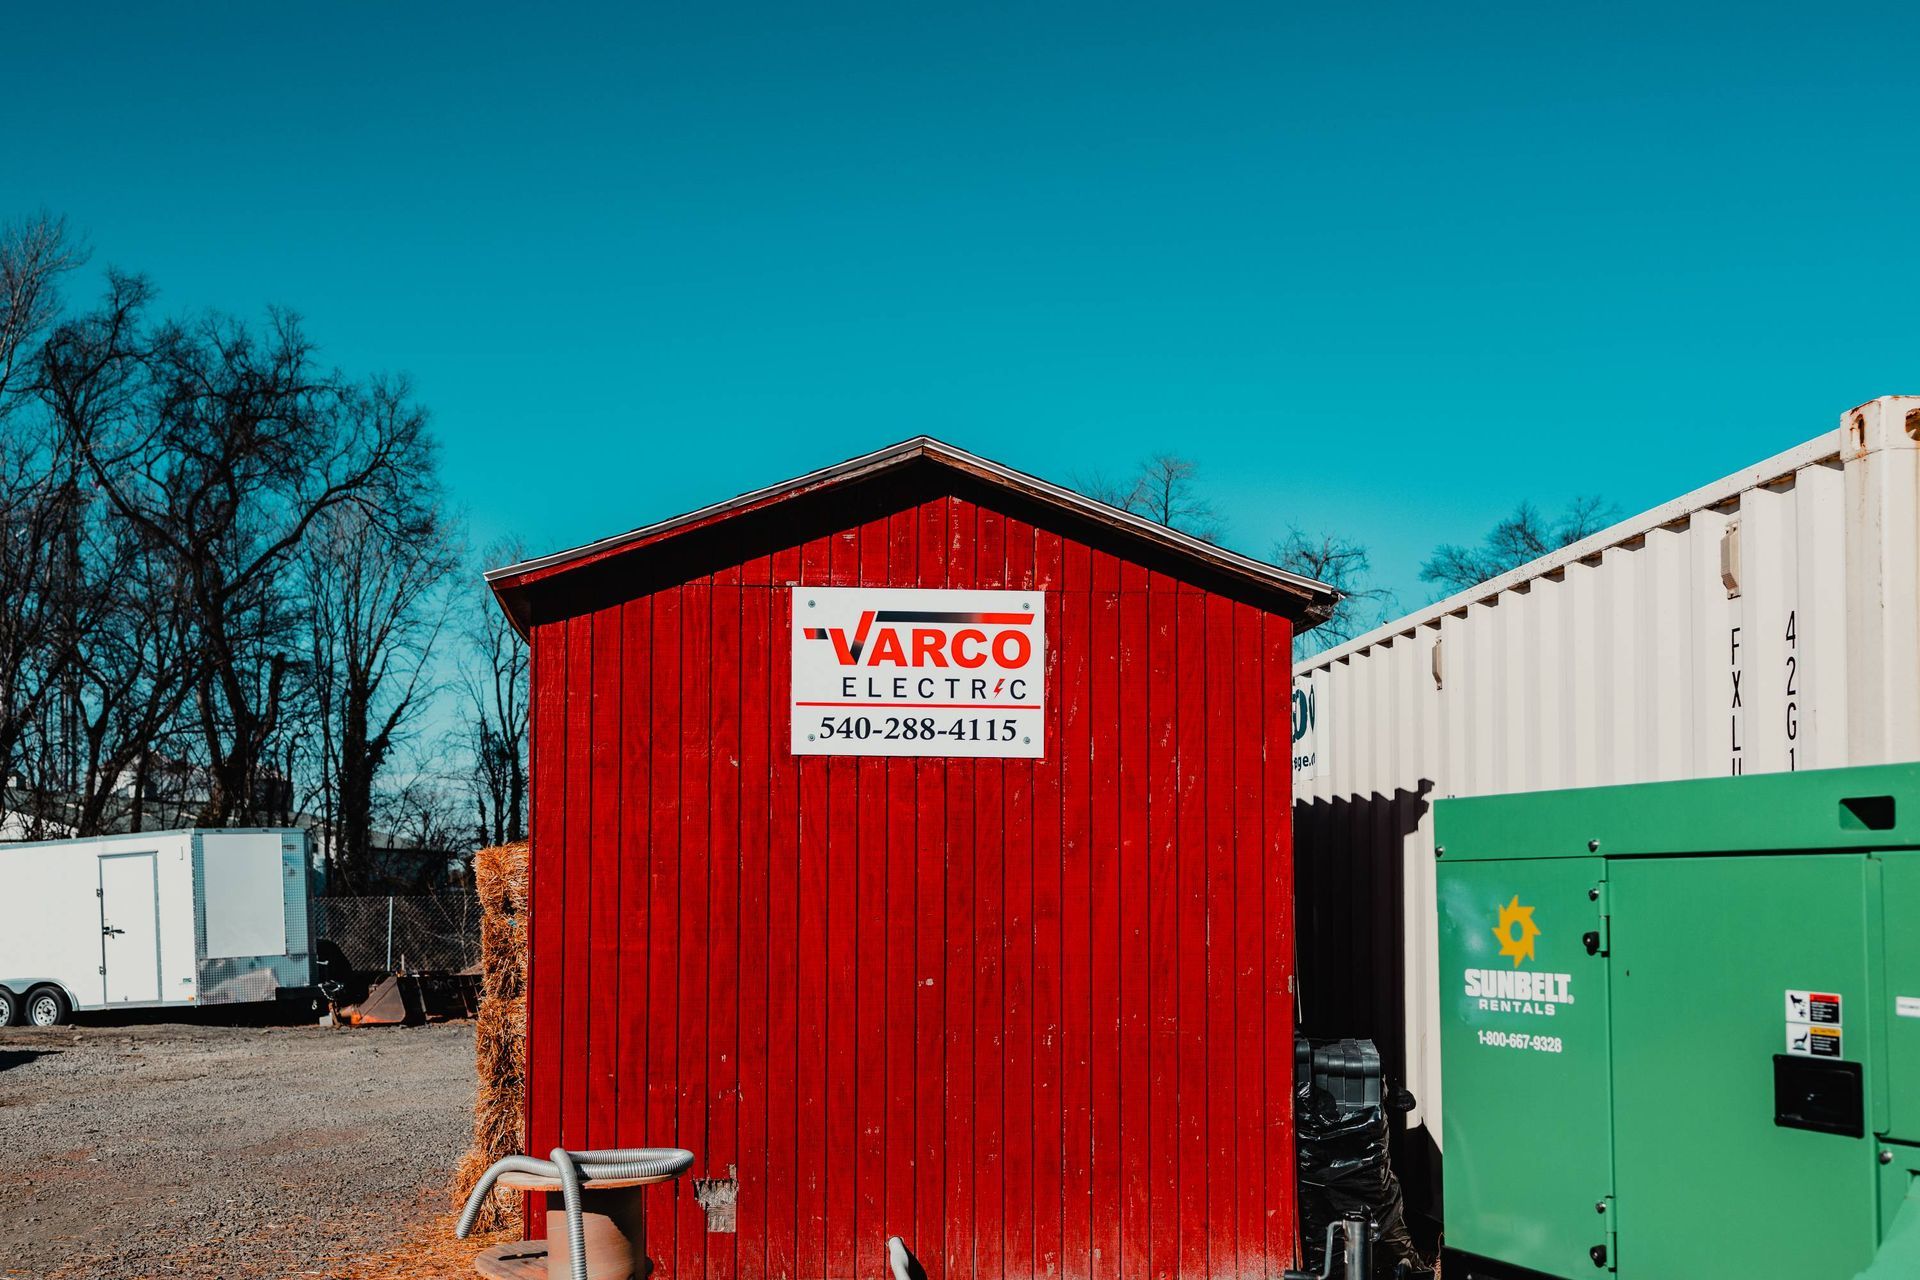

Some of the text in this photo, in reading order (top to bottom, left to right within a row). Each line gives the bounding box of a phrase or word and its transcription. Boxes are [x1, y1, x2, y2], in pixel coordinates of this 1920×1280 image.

[828, 611, 1031, 669] VARCO
[842, 676, 1027, 700] ELECTRIC
[819, 716, 1018, 742] 540-288-4115
[1464, 968, 1572, 1004] SUNBELT
[1479, 998, 1556, 1016] RENTALS
[1477, 1029, 1563, 1053] 1-800-667-9328
